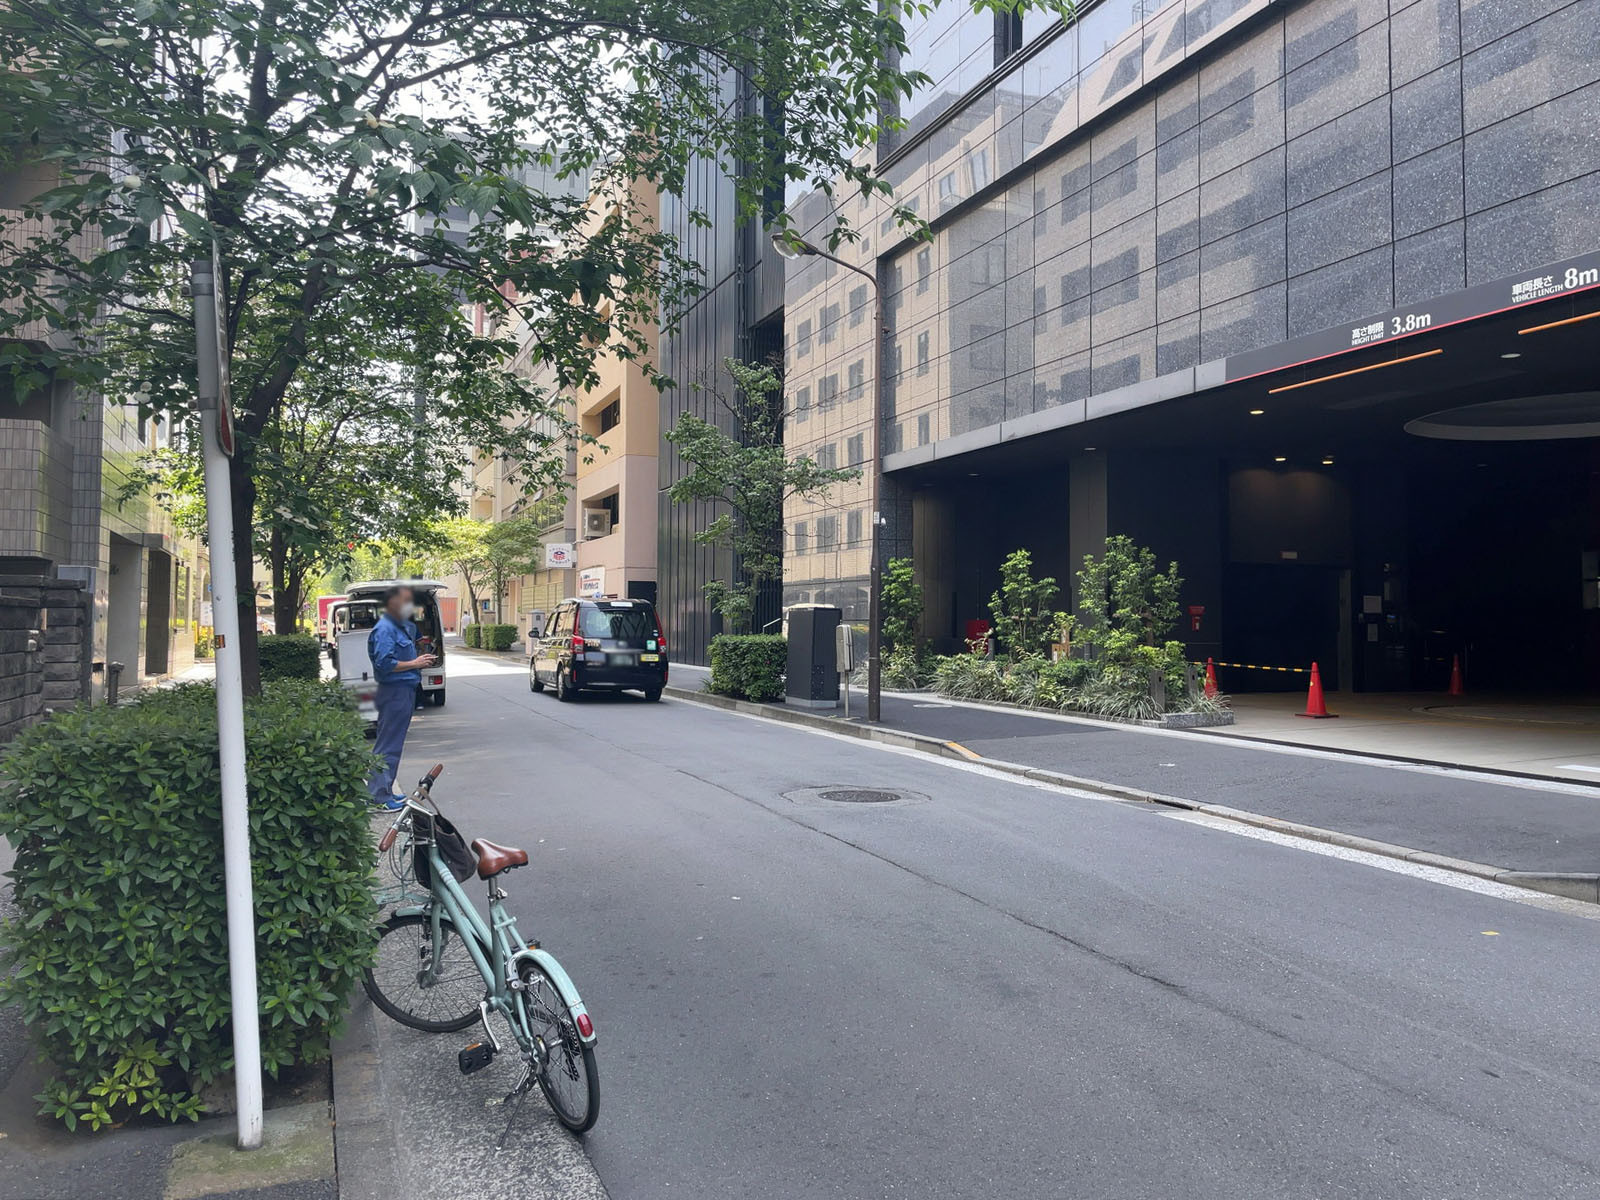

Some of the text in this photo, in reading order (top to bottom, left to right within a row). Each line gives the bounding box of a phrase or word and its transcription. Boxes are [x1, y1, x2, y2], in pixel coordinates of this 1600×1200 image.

[1512, 275, 1553, 295] 車両長さ
[1564, 268, 1598, 289] 8m
[1512, 284, 1564, 303] VEHICLE LENGTH
[1352, 321, 1384, 339] 高さ制限
[1391, 313, 1431, 335] 3.8m
[1352, 331, 1384, 346] HEIGHT LIMIT
